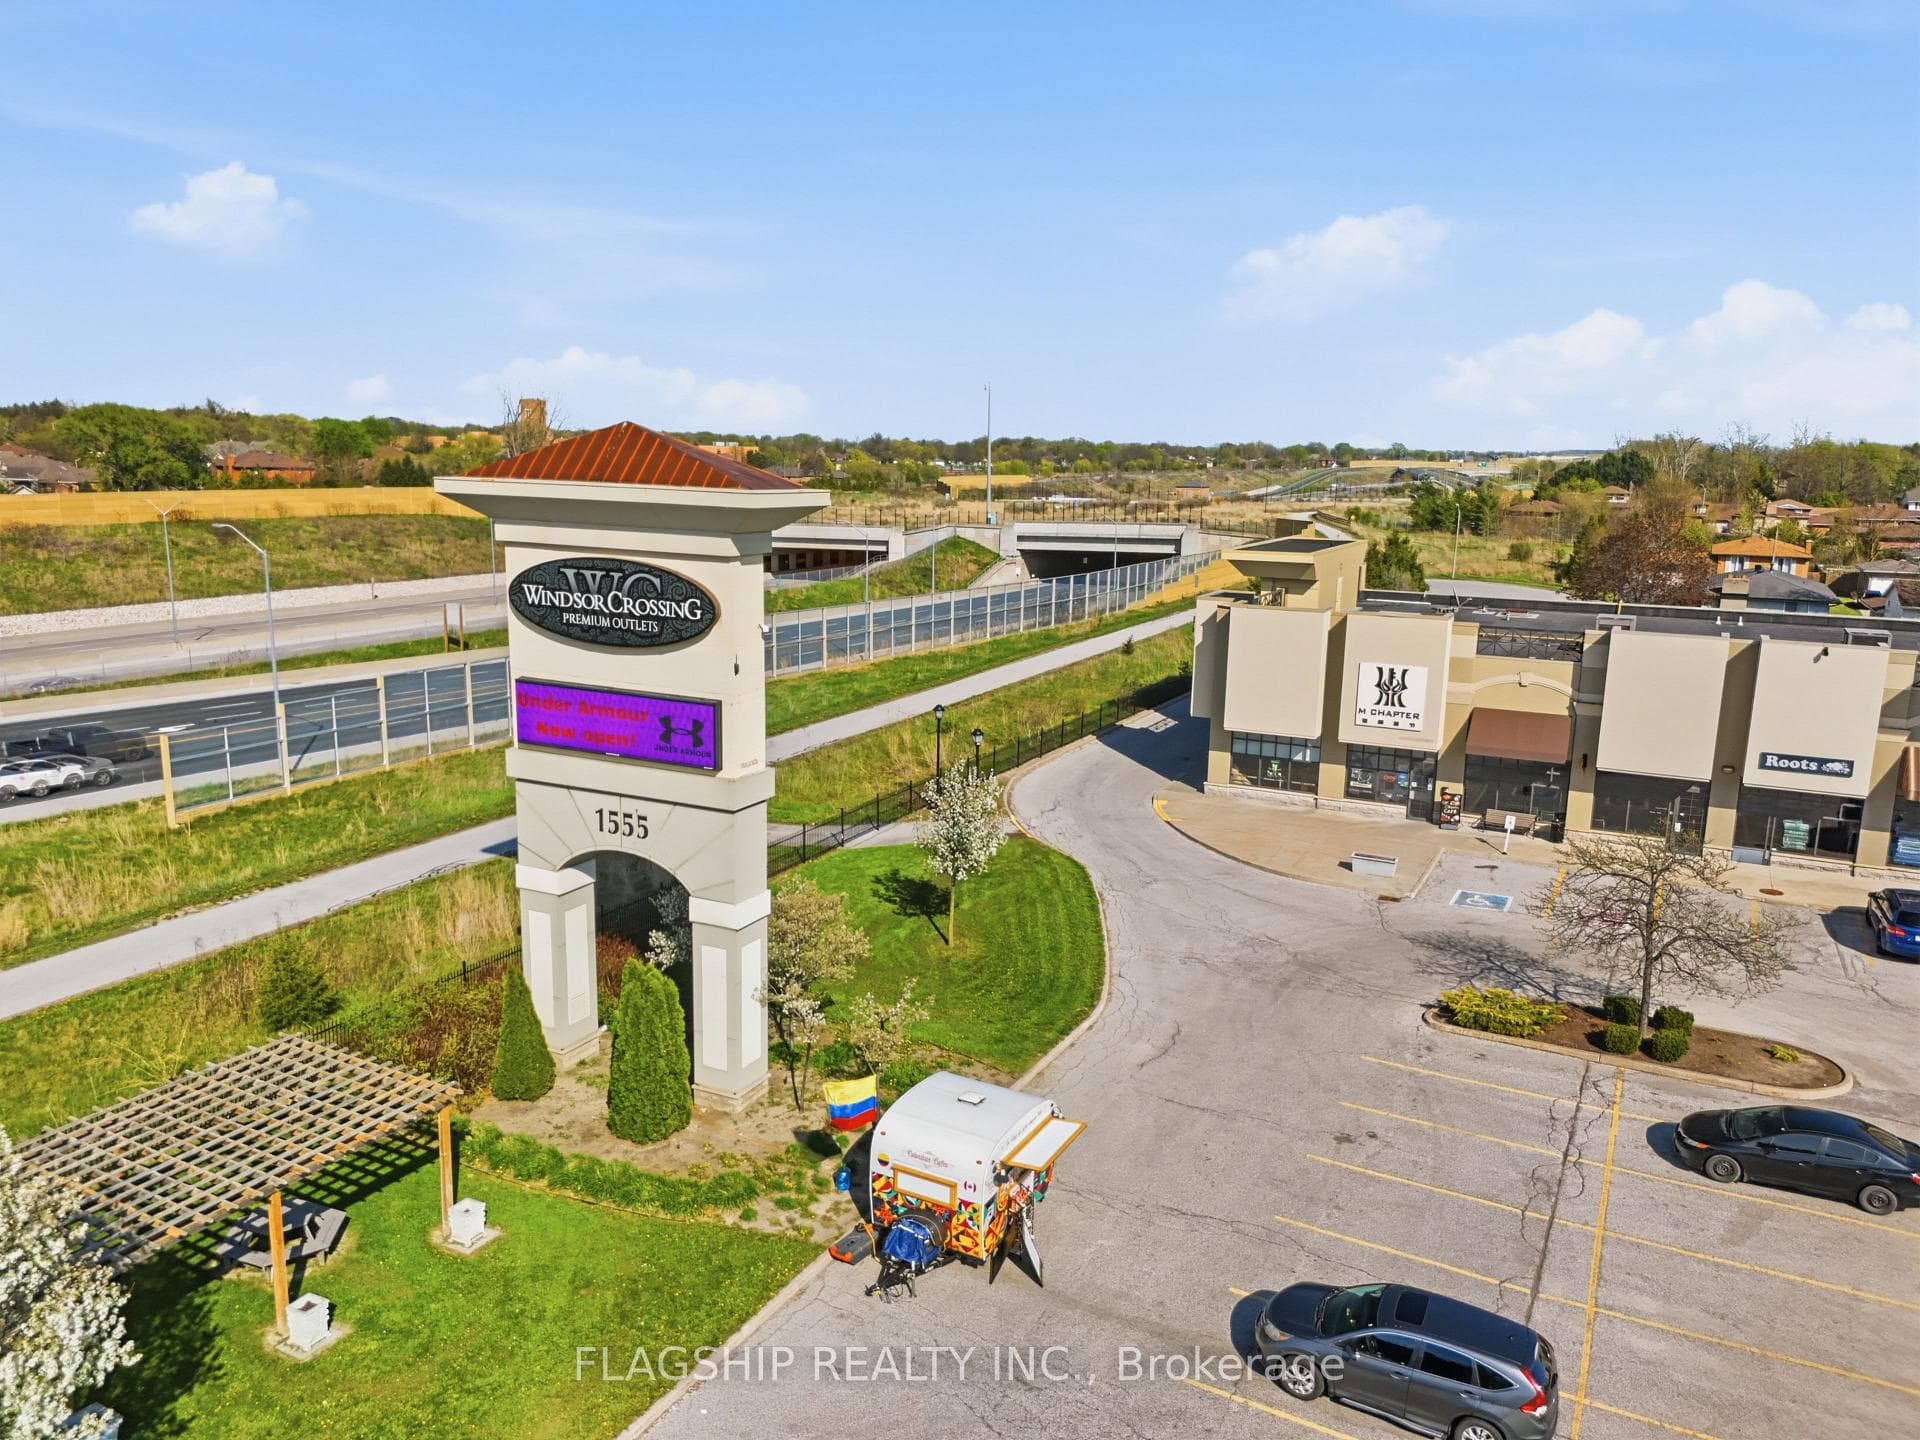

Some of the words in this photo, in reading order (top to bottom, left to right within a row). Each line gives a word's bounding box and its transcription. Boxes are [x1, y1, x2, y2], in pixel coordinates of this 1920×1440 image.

[562, 612, 611, 628] PREMIUM
[612, 617, 658, 633] OUTLETS
[518, 691, 571, 712] Under
[578, 700, 648, 721] Armour
[1358, 707, 1366, 715] M
[1370, 708, 1420, 721] CHAPTER
[680, 748, 713, 759] ARMOUR
[1765, 754, 1818, 771] Roots
[595, 807, 649, 840] 1555
